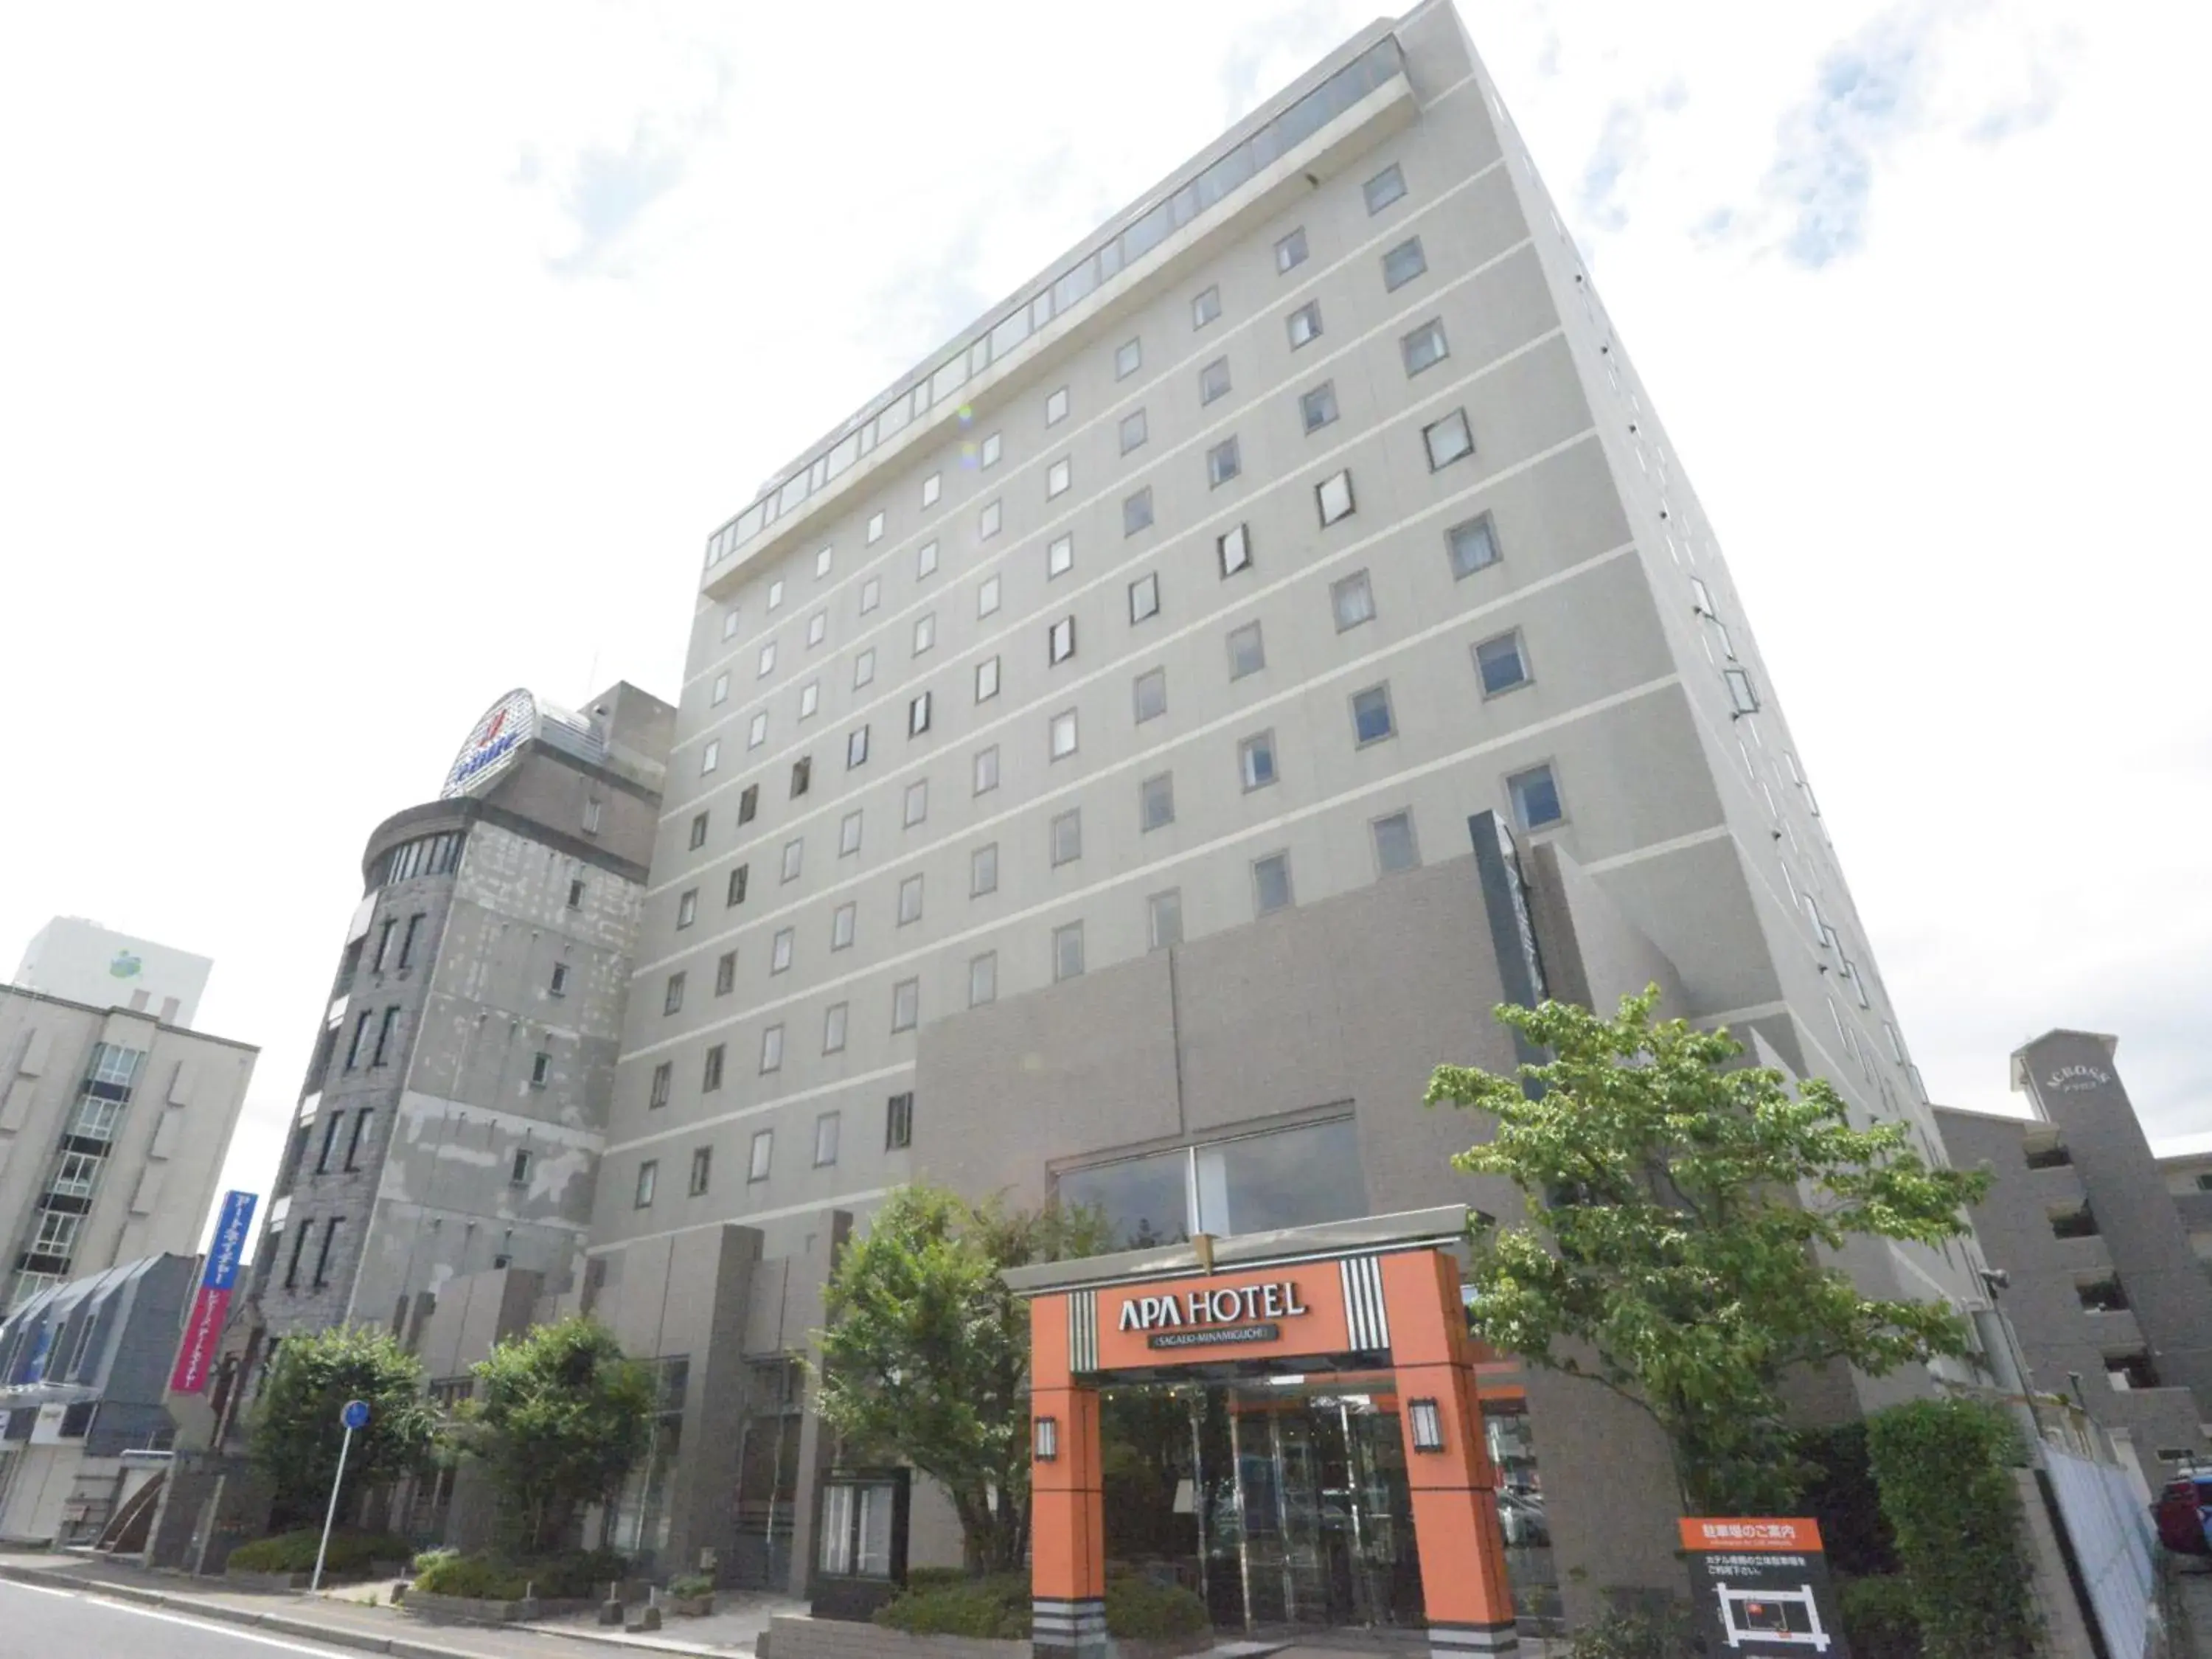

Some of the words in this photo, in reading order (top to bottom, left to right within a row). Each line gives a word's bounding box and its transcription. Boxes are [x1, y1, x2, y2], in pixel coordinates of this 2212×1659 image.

[1119, 1295, 1180, 1331] APA
[1188, 1282, 1305, 1326] HOTEL
[1702, 1524, 1796, 1539] 駐車場のご案内
